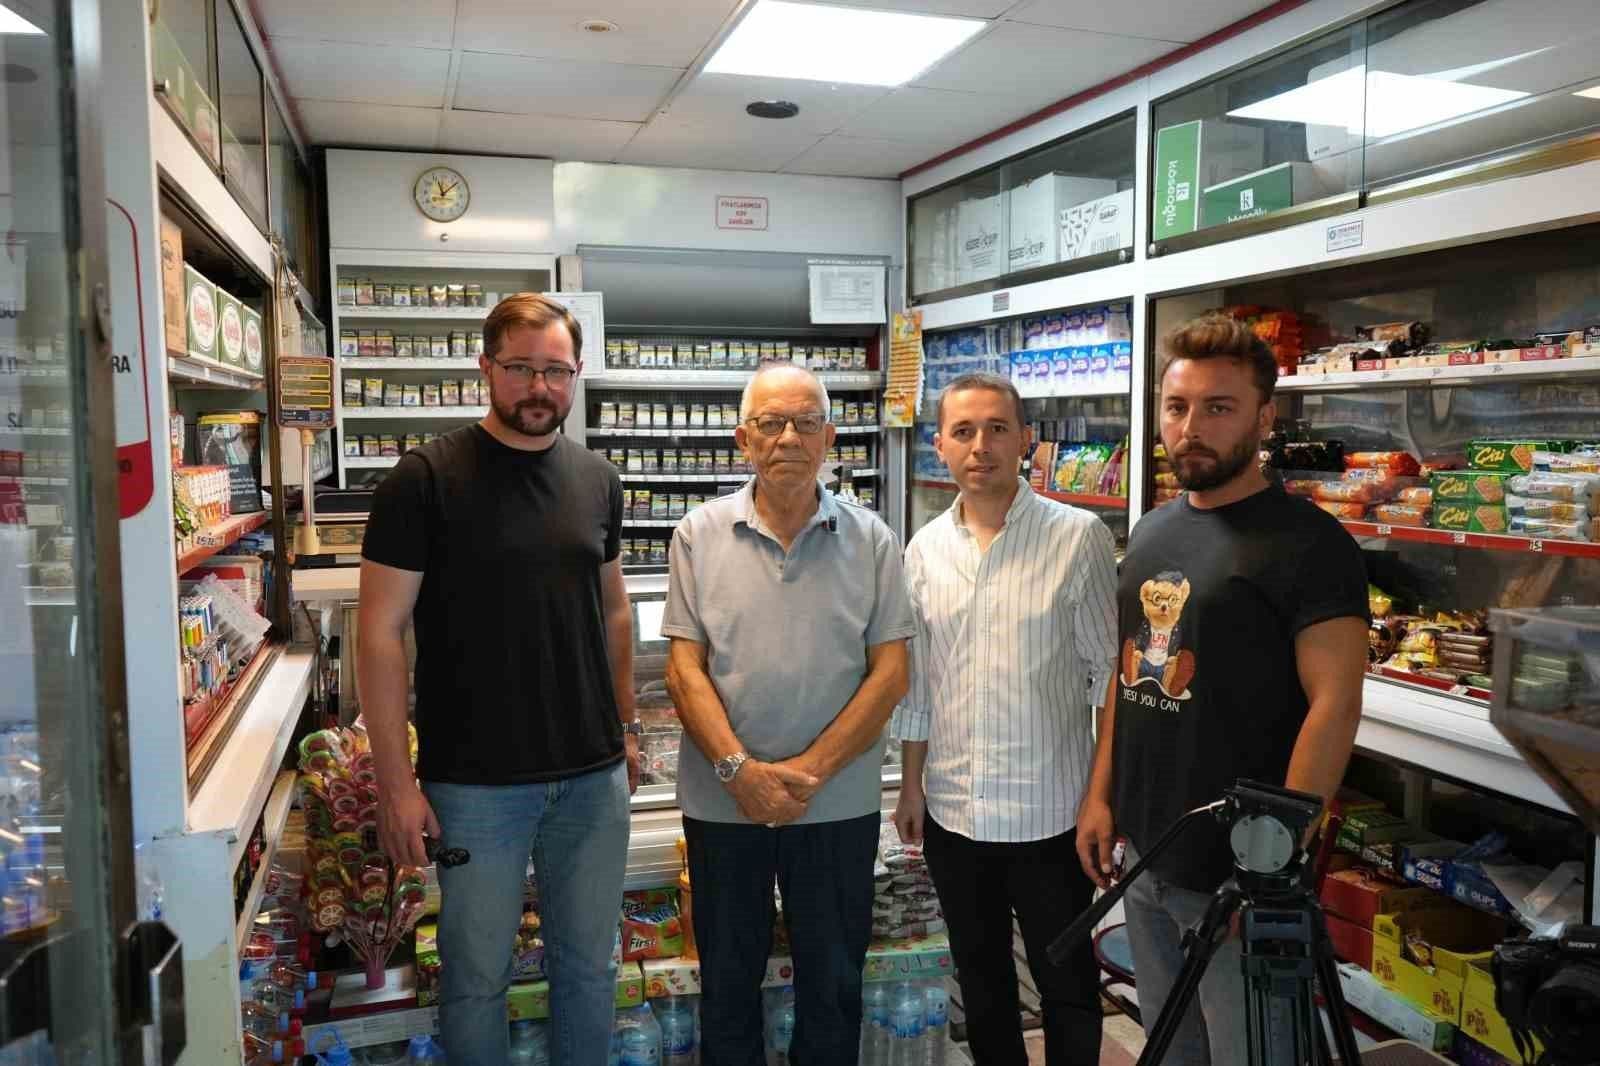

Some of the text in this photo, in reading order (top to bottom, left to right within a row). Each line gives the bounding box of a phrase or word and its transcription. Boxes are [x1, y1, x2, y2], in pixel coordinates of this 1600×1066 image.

[1140, 693, 1156, 707] YOU
[1160, 698, 1180, 713] CAN
[1567, 941, 1597, 949] SONY
